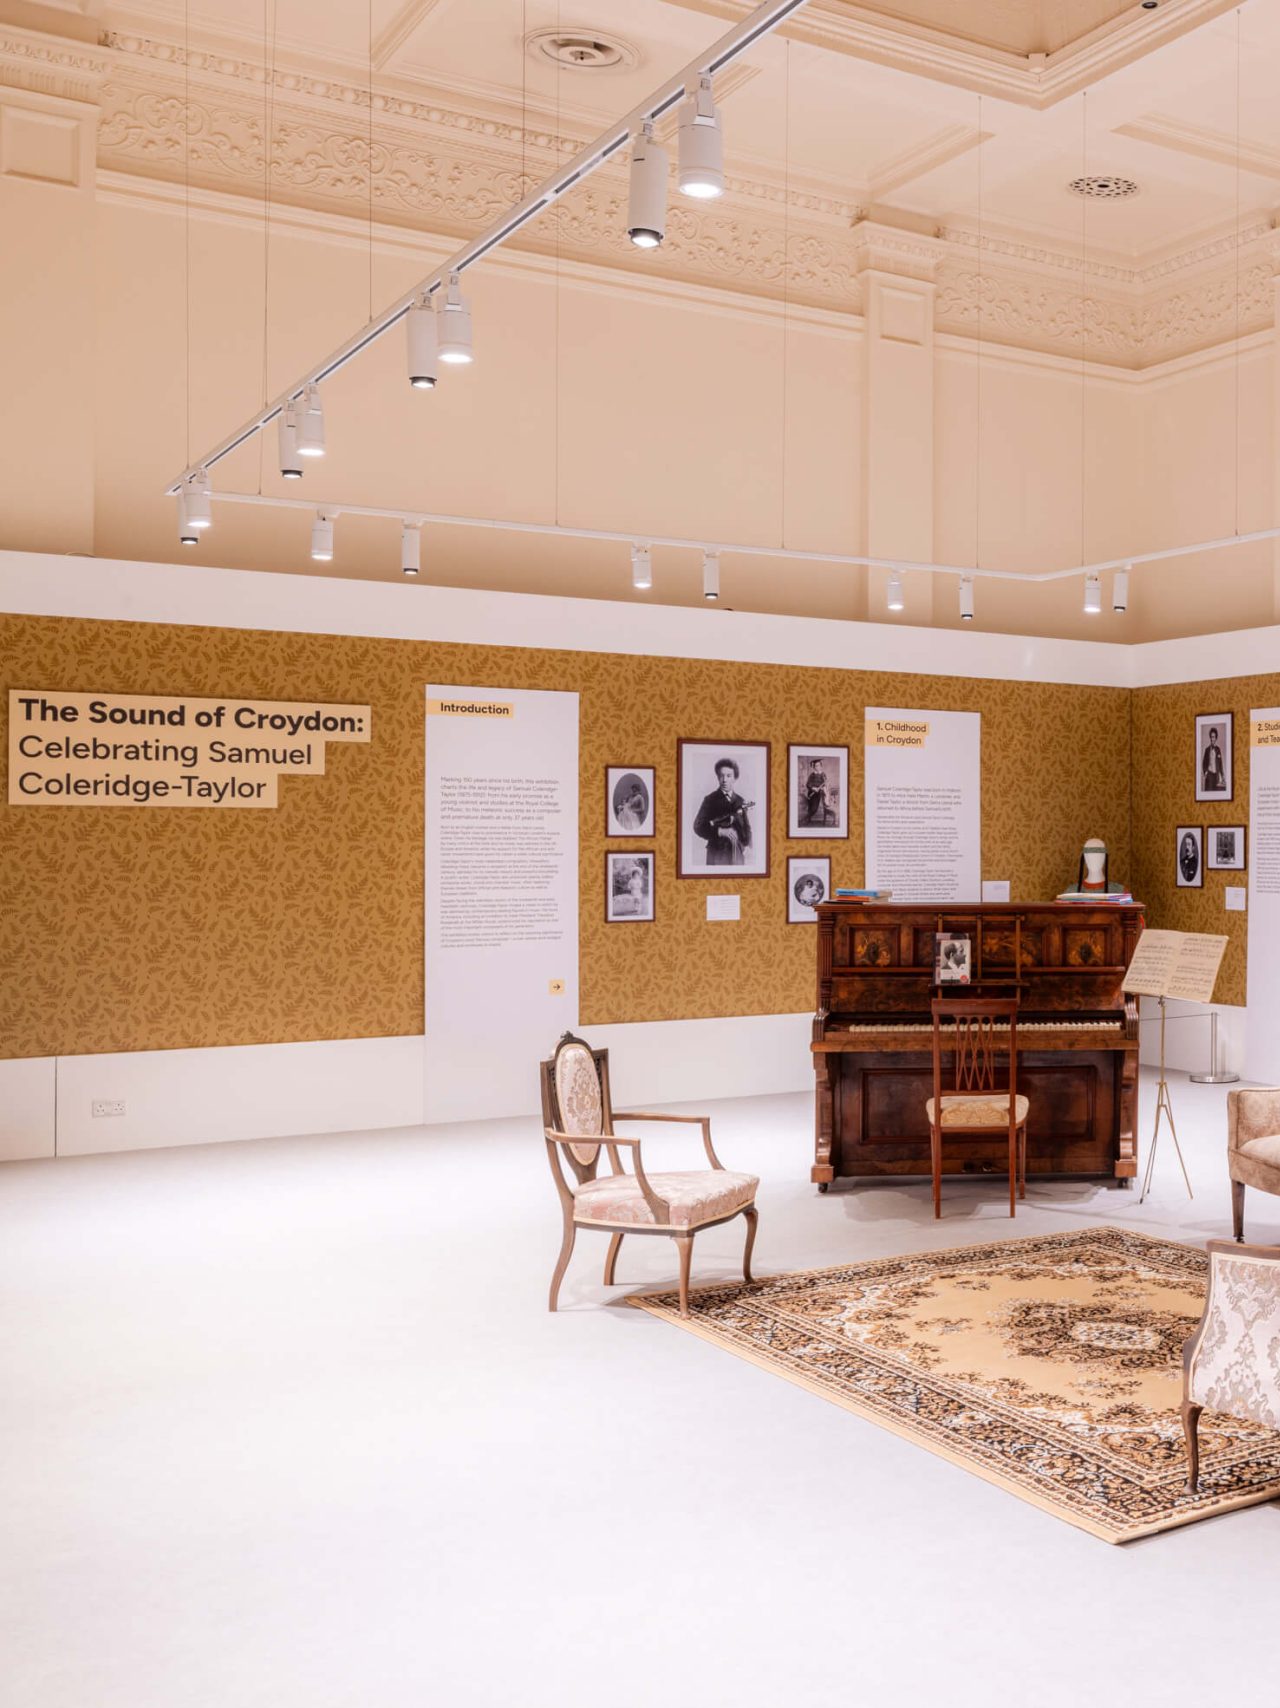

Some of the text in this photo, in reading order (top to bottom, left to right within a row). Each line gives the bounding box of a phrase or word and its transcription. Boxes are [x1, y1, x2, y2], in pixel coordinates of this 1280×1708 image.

[441, 702, 509, 714] Introduction
[18, 698, 363, 736] The Sound of Croydon:
[884, 722, 926, 732] Childhood
[877, 734, 921, 746] in Croydon
[1258, 735, 1269, 744] and
[19, 735, 311, 768] Celebrating Samuel
[19, 772, 266, 803] Coleridge-Taylor
